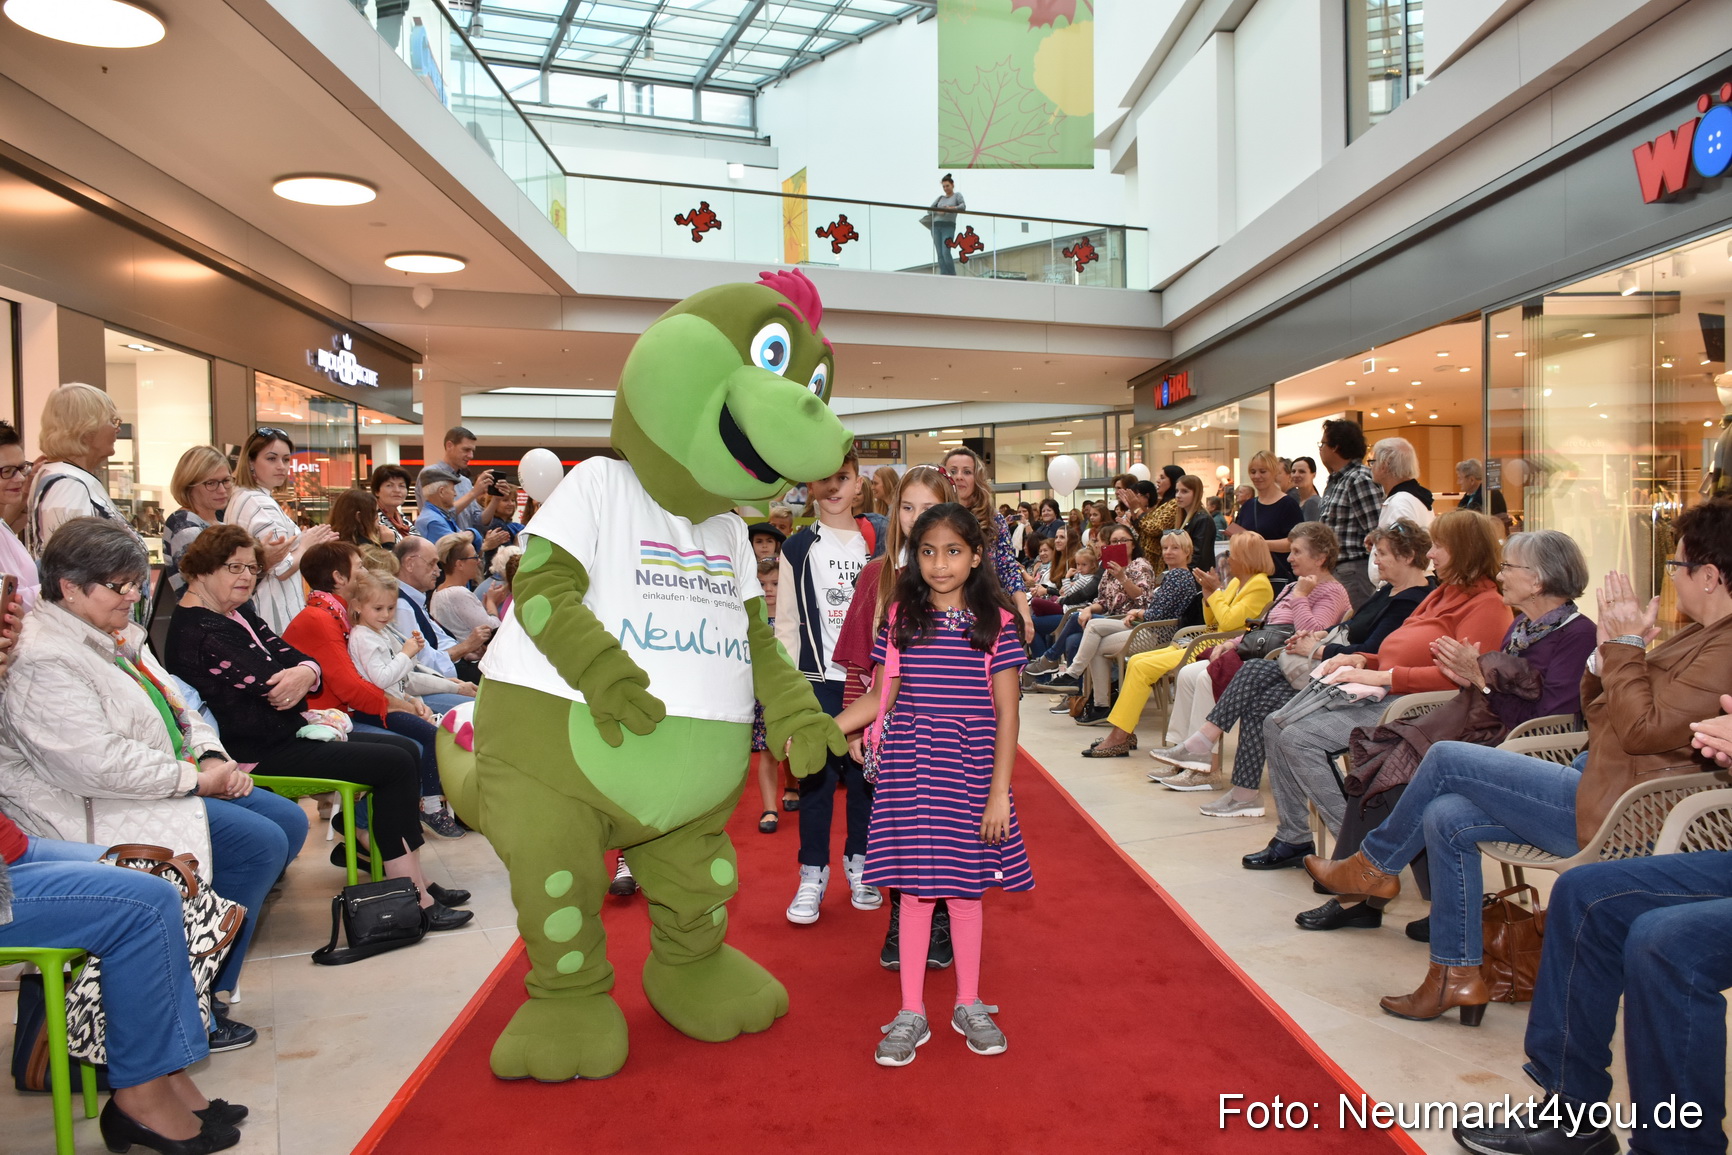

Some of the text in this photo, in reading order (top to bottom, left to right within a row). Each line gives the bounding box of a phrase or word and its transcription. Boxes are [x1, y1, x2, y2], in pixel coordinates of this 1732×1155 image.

[1153, 371, 1191, 409] WÖHRL
[829, 559, 863, 570] PLEIN
[635, 569, 738, 598] NeuerMark
[642, 591, 742, 612] einkaufen leben genießen
[828, 610, 843, 618] LES
